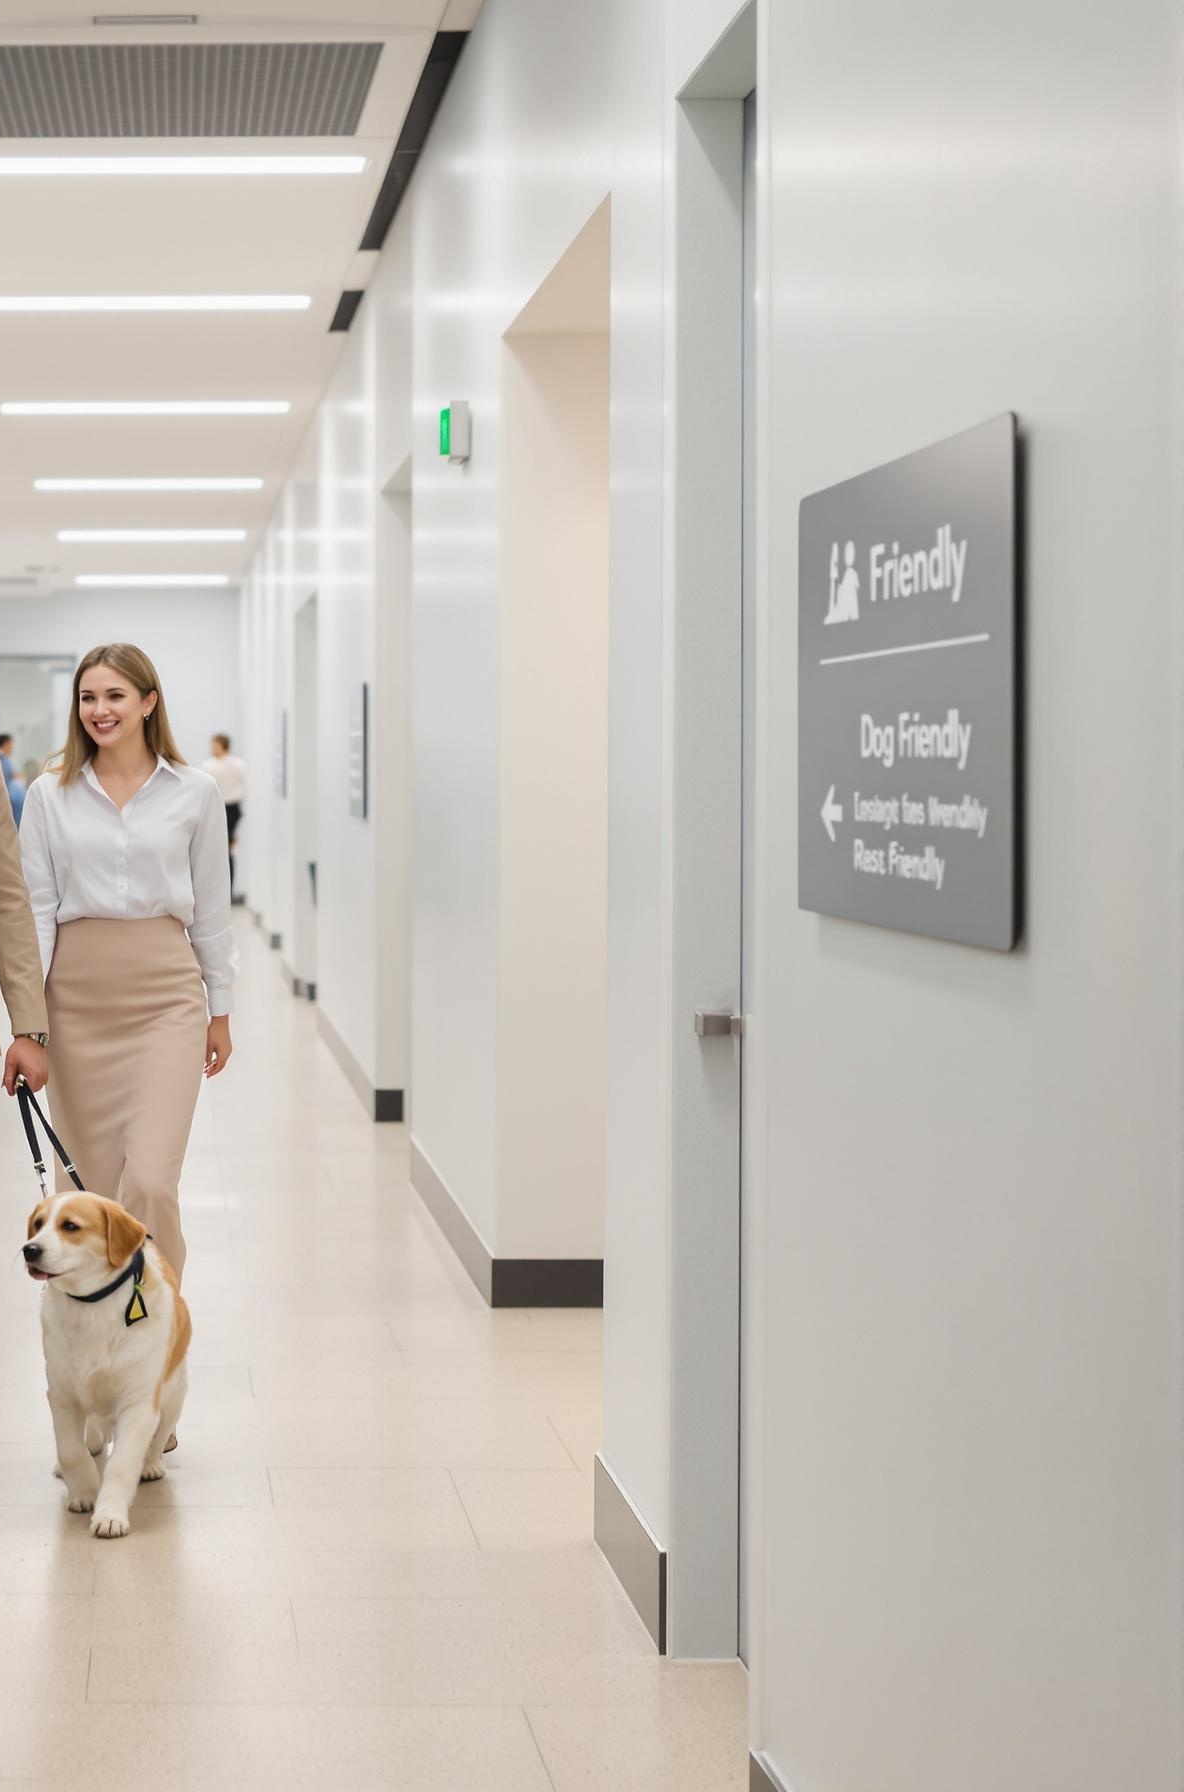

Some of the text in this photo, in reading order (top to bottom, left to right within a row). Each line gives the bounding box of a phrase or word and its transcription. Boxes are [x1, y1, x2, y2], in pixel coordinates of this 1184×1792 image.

[870, 523, 967, 603] Friendly
[861, 708, 972, 771] Dog Friendly
